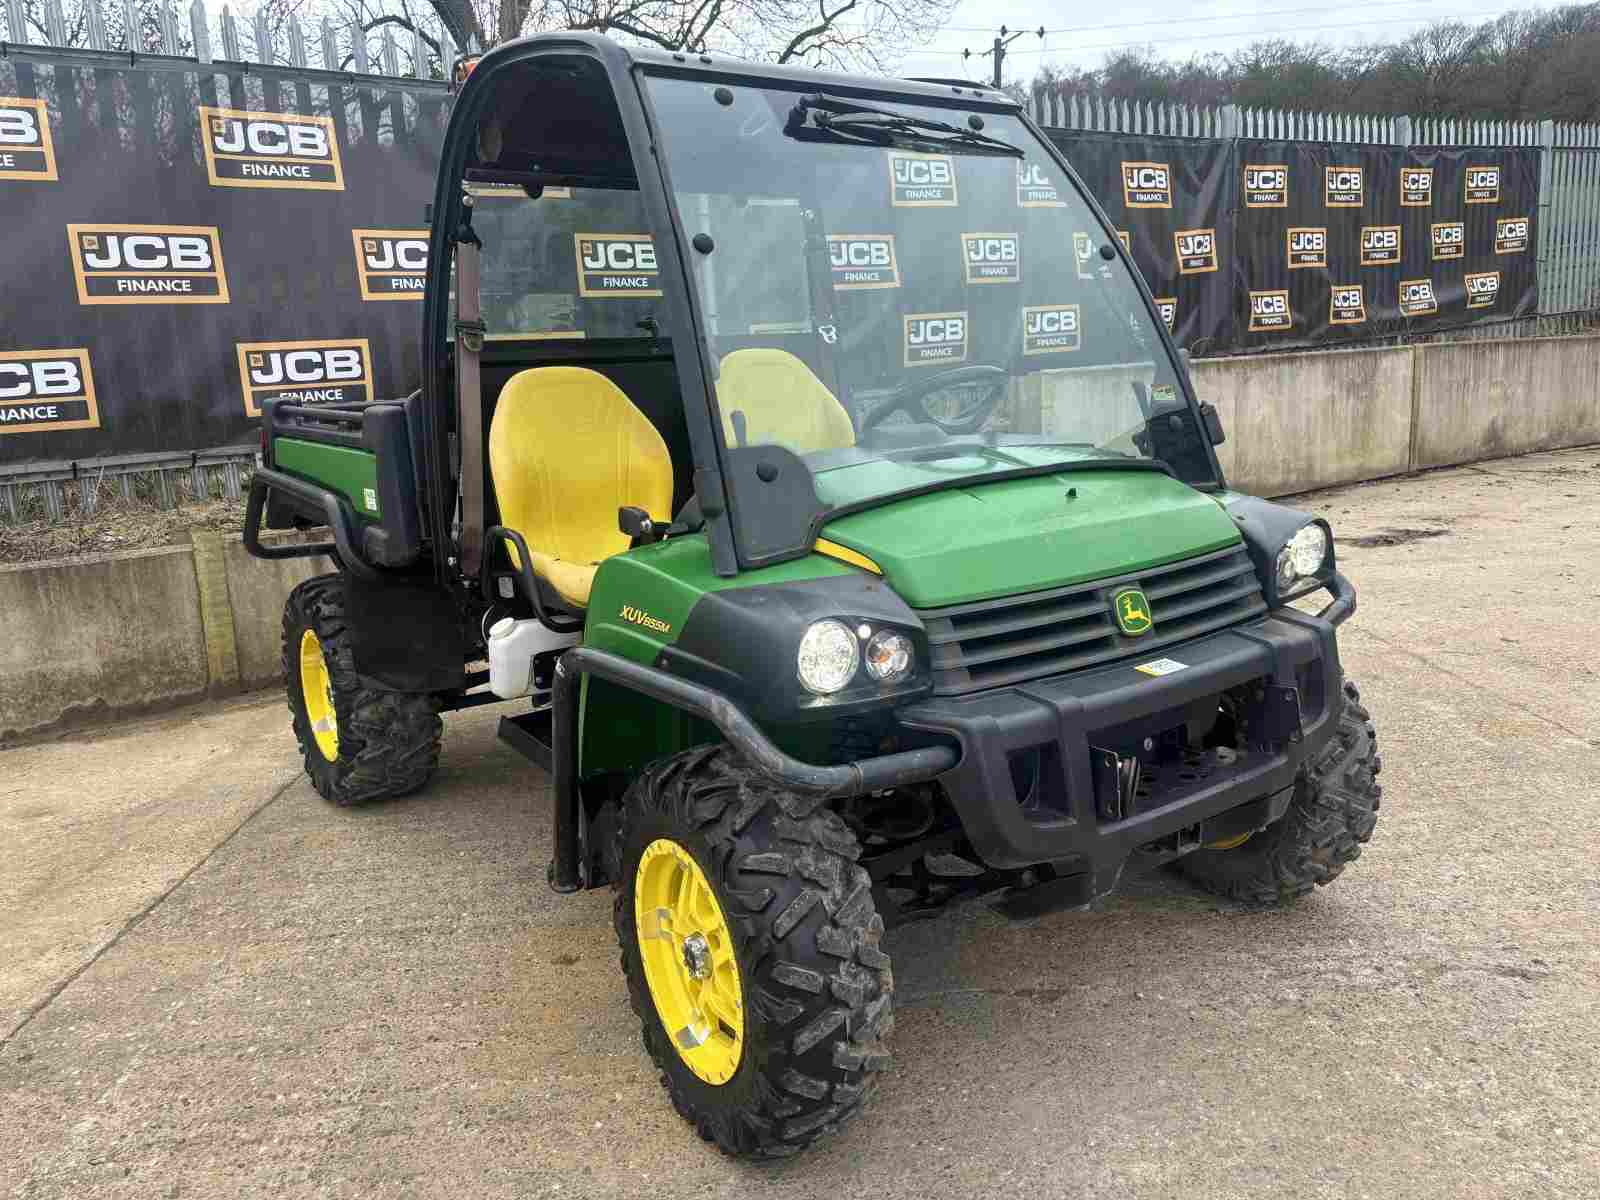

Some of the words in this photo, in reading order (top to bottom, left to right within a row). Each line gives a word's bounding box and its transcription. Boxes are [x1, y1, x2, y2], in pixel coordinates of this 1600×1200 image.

[214, 121, 328, 156] JCB
[242, 164, 312, 178] FINANCE
[896, 160, 950, 183] JCB
[1127, 169, 1167, 188] JCB
[1247, 171, 1285, 188] JCB
[1468, 172, 1497, 187] JCB
[1328, 173, 1360, 189] JCB
[1404, 173, 1430, 189] JCB
[1435, 228, 1461, 243] JCB
[1498, 223, 1526, 238] JCB
[1180, 235, 1210, 255] JCB
[1292, 233, 1323, 250] JCB
[1364, 231, 1396, 248] JCB
[85, 235, 212, 268] JCB
[366, 240, 428, 269] JC
[583, 243, 657, 269] JCB
[831, 242, 890, 265] JCB
[970, 240, 1016, 261] JCB
[117, 279, 193, 291] FINANCE
[391, 279, 425, 290] FINA
[603, 277, 648, 288] FINANCE
[844, 272, 881, 281] FINANCE
[1469, 276, 1498, 292] JCB
[1334, 291, 1360, 306] JCB
[1402, 285, 1431, 300] JCB
[1254, 296, 1285, 313] JCB
[909, 319, 964, 342] JCB
[1029, 311, 1076, 333] JCB
[251, 350, 363, 384] JCB
[0, 361, 81, 398] CB
